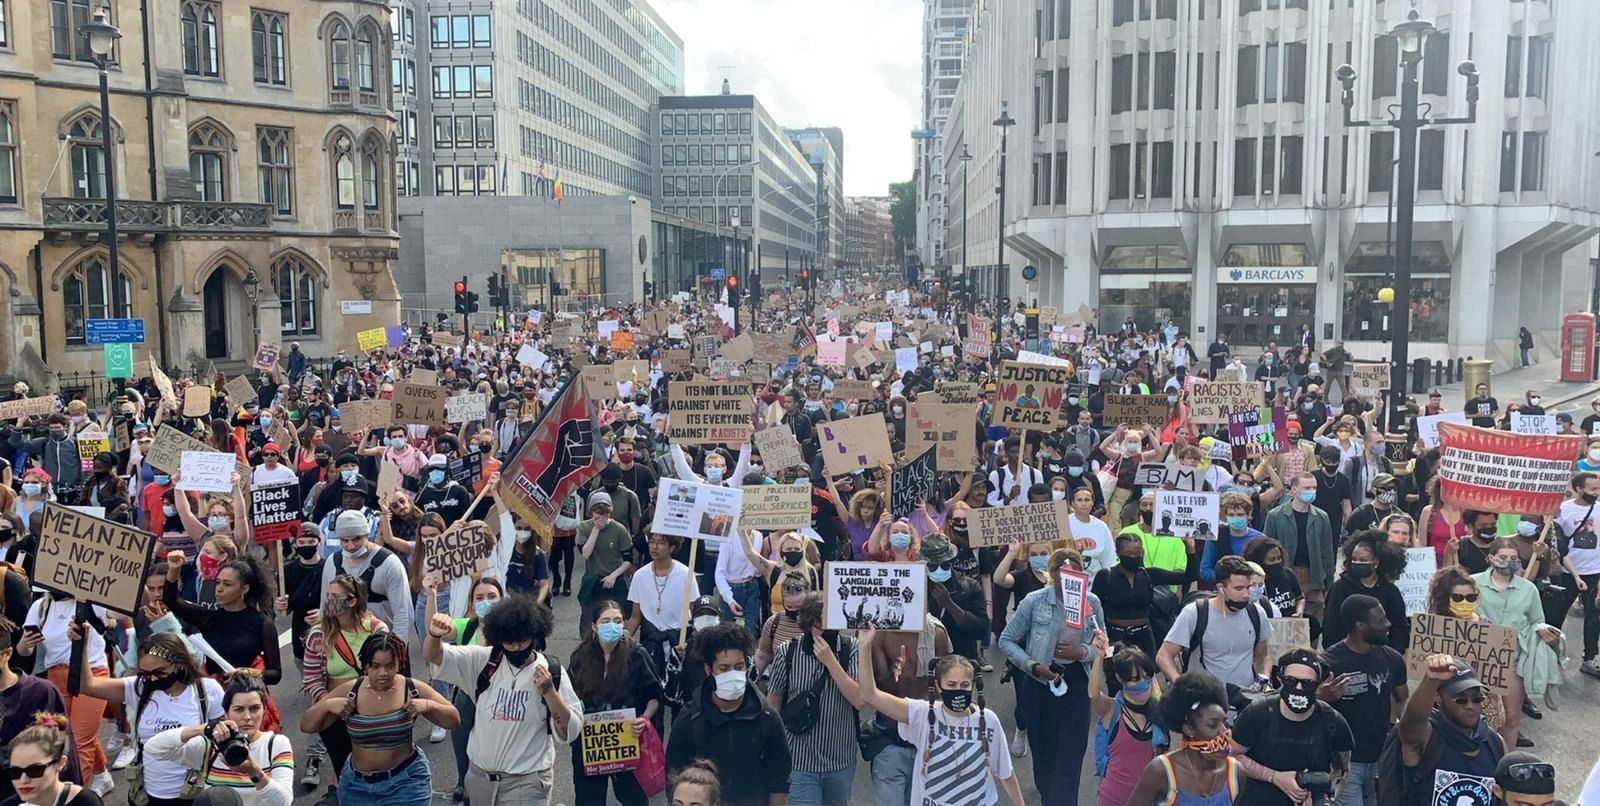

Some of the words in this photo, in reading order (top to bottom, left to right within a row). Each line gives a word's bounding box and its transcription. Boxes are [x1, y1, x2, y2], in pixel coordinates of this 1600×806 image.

[1245, 270, 1304, 280] BARCLAYS
[1002, 366, 1066, 384] JUSTICE
[685, 386, 699, 396] ITS
[701, 385, 720, 396] NOT
[722, 385, 750, 396] BLACK
[998, 383, 1018, 402] NO
[1194, 384, 1242, 397] RACISTS
[456, 396, 484, 405] BLACK
[670, 400, 710, 411] AGAINST
[713, 400, 741, 410] WHITE
[1042, 387, 1062, 410] NO
[1107, 395, 1137, 406] BLACK
[1194, 397, 1228, 405] WITHOUT
[1231, 397, 1254, 405] BLACK
[448, 404, 472, 415] LIVES
[1002, 406, 1051, 425] PEACE
[1120, 406, 1149, 415] LIVES
[1191, 407, 1214, 417] LIVES
[1218, 405, 1231, 419] YA
[687, 414, 700, 425] ITS
[703, 414, 750, 424] EVERYONE
[1105, 416, 1143, 425] MATTER
[1148, 416, 1164, 425] TOO
[1519, 416, 1546, 427] STOP
[161, 426, 186, 445] THEY
[670, 428, 707, 438] AGAINST
[711, 428, 747, 438] RACISTS
[824, 427, 834, 441] B
[151, 447, 174, 467] THEM
[1446, 448, 1456, 458] IN
[1457, 450, 1473, 461] THE
[1474, 453, 1491, 464] END
[1492, 455, 1506, 466] WE
[1507, 457, 1528, 468] WILL
[1528, 459, 1571, 471] REMEMBER
[893, 454, 930, 494] BLACK
[1441, 457, 1458, 469] NOT
[1459, 460, 1476, 472] THE
[1477, 464, 1508, 477] WORDS
[1510, 469, 1521, 479] OF
[1538, 472, 1570, 482] ENEMIES
[517, 476, 535, 493] BLACK
[1456, 472, 1473, 484] THE
[1473, 475, 1506, 489] SILENCE
[1507, 481, 1519, 490] OF
[1537, 483, 1568, 493] FRIENDS
[252, 487, 290, 503] Black
[789, 486, 810, 494] FUNDS
[253, 501, 287, 514] Lives
[743, 503, 768, 511] SOCIAL
[769, 501, 809, 511] SERVICES
[1162, 495, 1175, 505] ALL
[1177, 496, 1189, 505] WE
[1189, 496, 1208, 506] EVER
[978, 507, 1006, 519] JUST
[1012, 502, 1056, 516] BECAUSE
[1177, 506, 1192, 514] DID
[254, 510, 298, 526] Matter
[980, 519, 991, 528] IT
[995, 516, 1024, 526] DOESNT
[1028, 513, 1056, 524] AFFECT
[1174, 518, 1195, 527] BLACK
[981, 528, 995, 536] YOU
[998, 525, 1029, 534] DOESNT
[1033, 521, 1058, 532] MEAN
[426, 525, 484, 556] RACISTS
[982, 535, 994, 545] IT
[998, 532, 1031, 544] DOESNT
[1034, 529, 1060, 541] EXIST
[40, 535, 61, 555] IS
[69, 542, 105, 566] NOT
[108, 554, 142, 579] YOUR
[1407, 552, 1426, 562] MUST
[442, 560, 477, 582] MUM
[834, 568, 871, 576] SILENCE
[878, 568, 888, 577] IS
[894, 569, 911, 577] THE
[53, 562, 117, 597] ENEMY
[840, 577, 883, 586] LANGUAGE
[1065, 578, 1082, 592] BLACK
[850, 586, 901, 598] COWARDS
[1275, 587, 1280, 595] I
[1415, 614, 1490, 645] SILENCE
[1503, 629, 1513, 638] IS
[1413, 634, 1486, 662] POLITICAL
[1486, 647, 1515, 666] ACT
[1502, 638, 1511, 648] A
[583, 722, 624, 737] BLACK
[584, 734, 620, 750] LIVES
[585, 745, 637, 763] MATTER
[598, 763, 625, 772] justice
